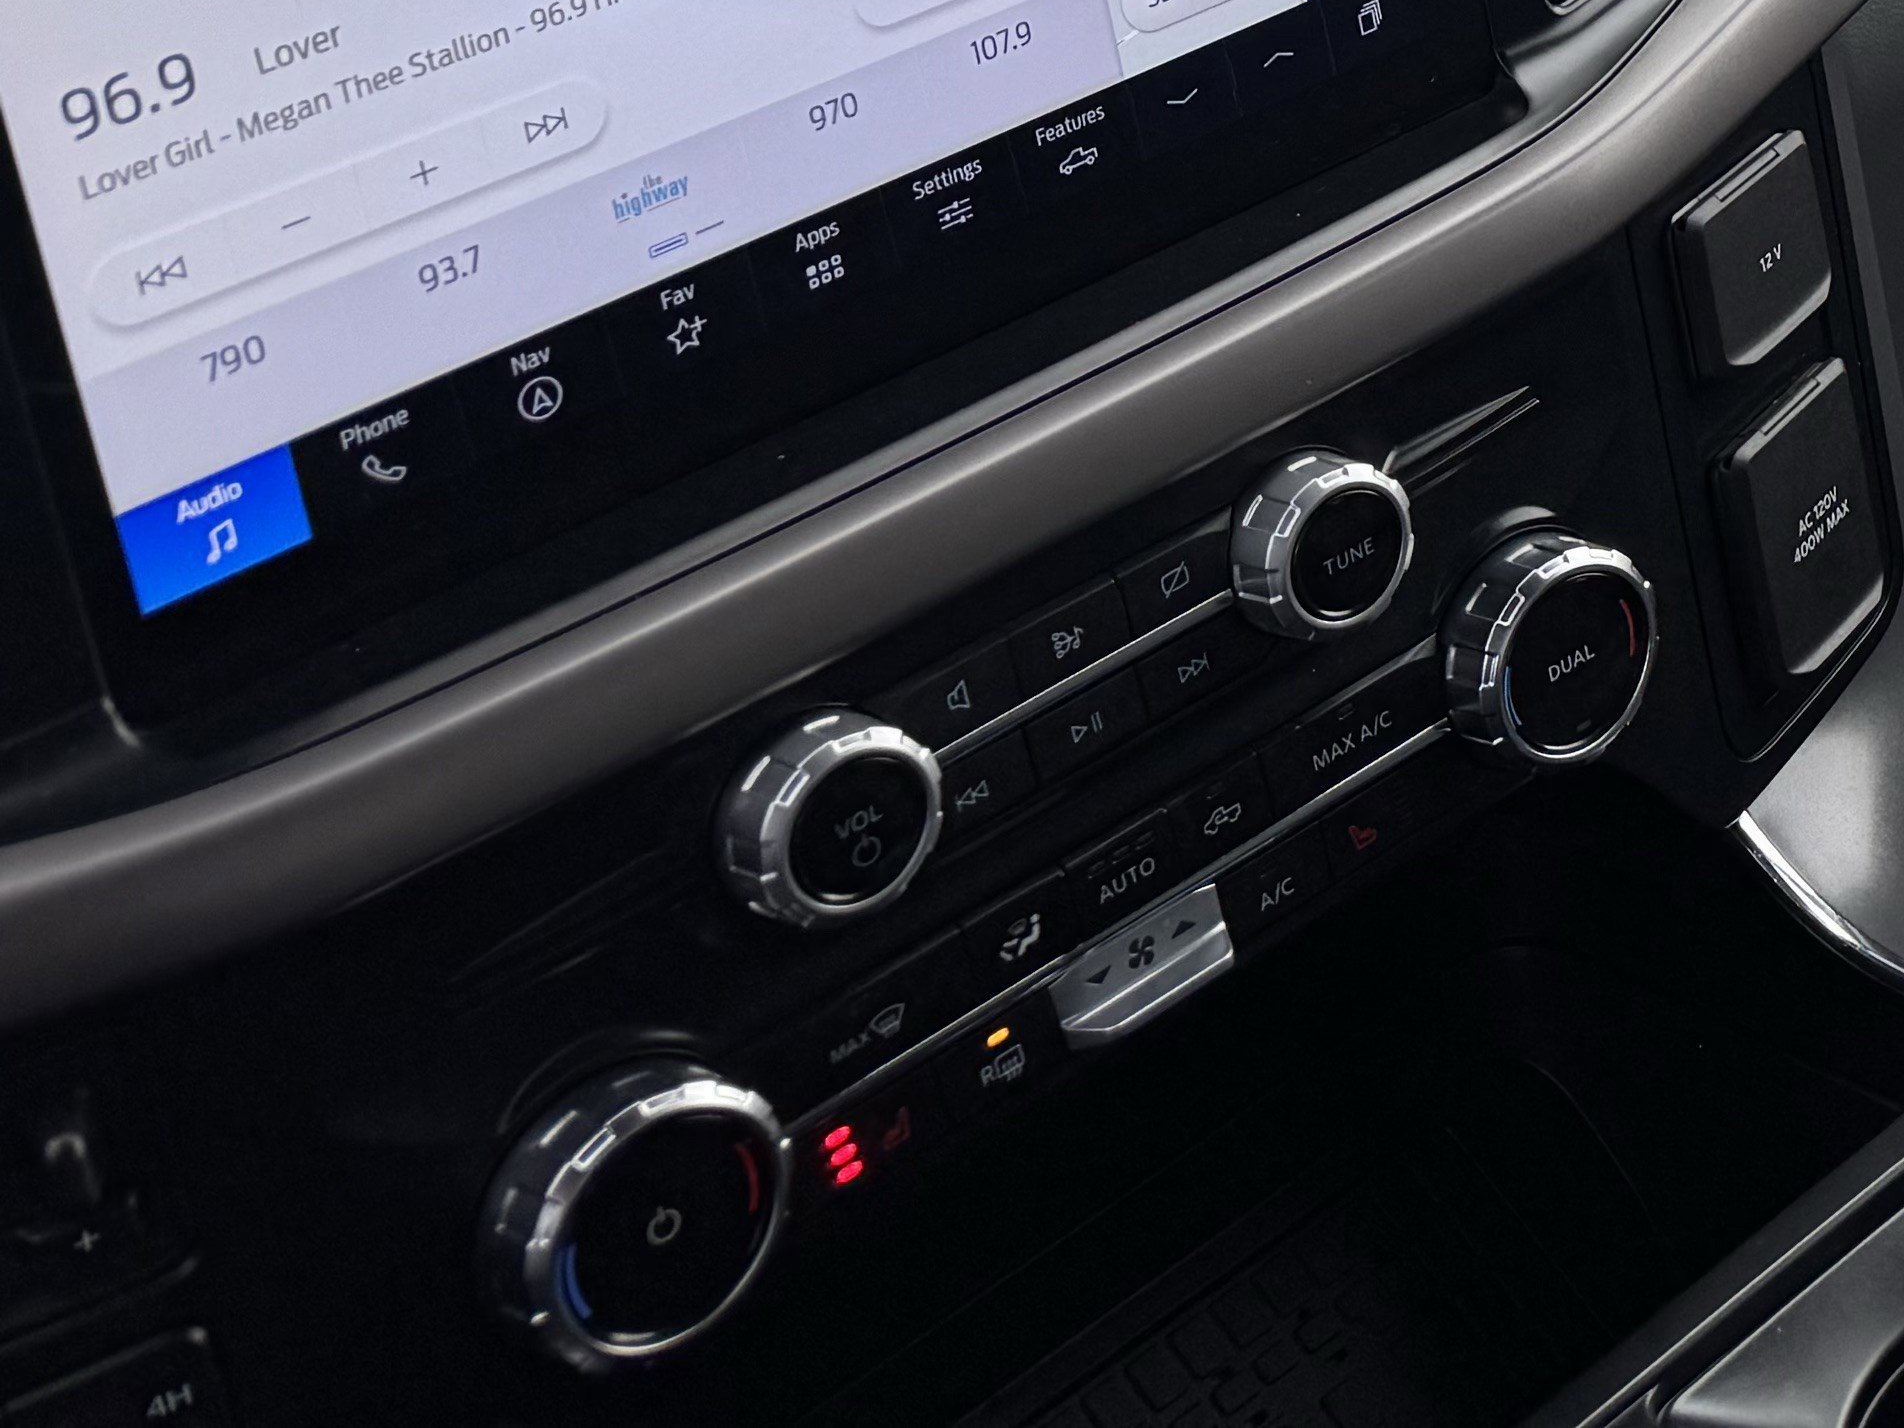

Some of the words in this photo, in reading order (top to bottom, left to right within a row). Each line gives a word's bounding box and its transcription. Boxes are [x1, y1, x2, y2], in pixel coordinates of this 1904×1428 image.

[969, 20, 1034, 67] 107.9
[59, 51, 198, 142] 96.9
[252, 25, 342, 76] Lover
[78, 157, 160, 201] Lover
[164, 128, 216, 169] Girl
[236, 92, 333, 143] Megan
[334, 62, 406, 107] Thee
[407, 22, 511, 79] Stallion
[807, 91, 860, 133] 970
[1034, 104, 1107, 148] Features
[611, 174, 689, 223] highway
[911, 157, 984, 202] Settings
[794, 219, 842, 254] Apps
[418, 244, 482, 294] 93.7
[659, 281, 696, 312] Fav
[200, 334, 267, 383] 790
[509, 344, 552, 378] Nav
[338, 406, 410, 452] Phone
[175, 478, 244, 524] Audio
[1797, 512, 1814, 537] AC
[1813, 485, 1839, 521] 120V
[1793, 523, 1826, 564] 400W
[1826, 498, 1852, 533] MAX
[1322, 536, 1376, 576] TUNE
[1547, 644, 1597, 683] DUAL
[1311, 732, 1357, 772] MAX
[1359, 709, 1393, 743] A/C
[834, 804, 884, 841] VOL
[1099, 856, 1156, 905] AUTO
[1260, 876, 1296, 913] A/C
[829, 1032, 873, 1064] MAX
[979, 1065, 995, 1087] R
[146, 1383, 193, 1418] 4H
